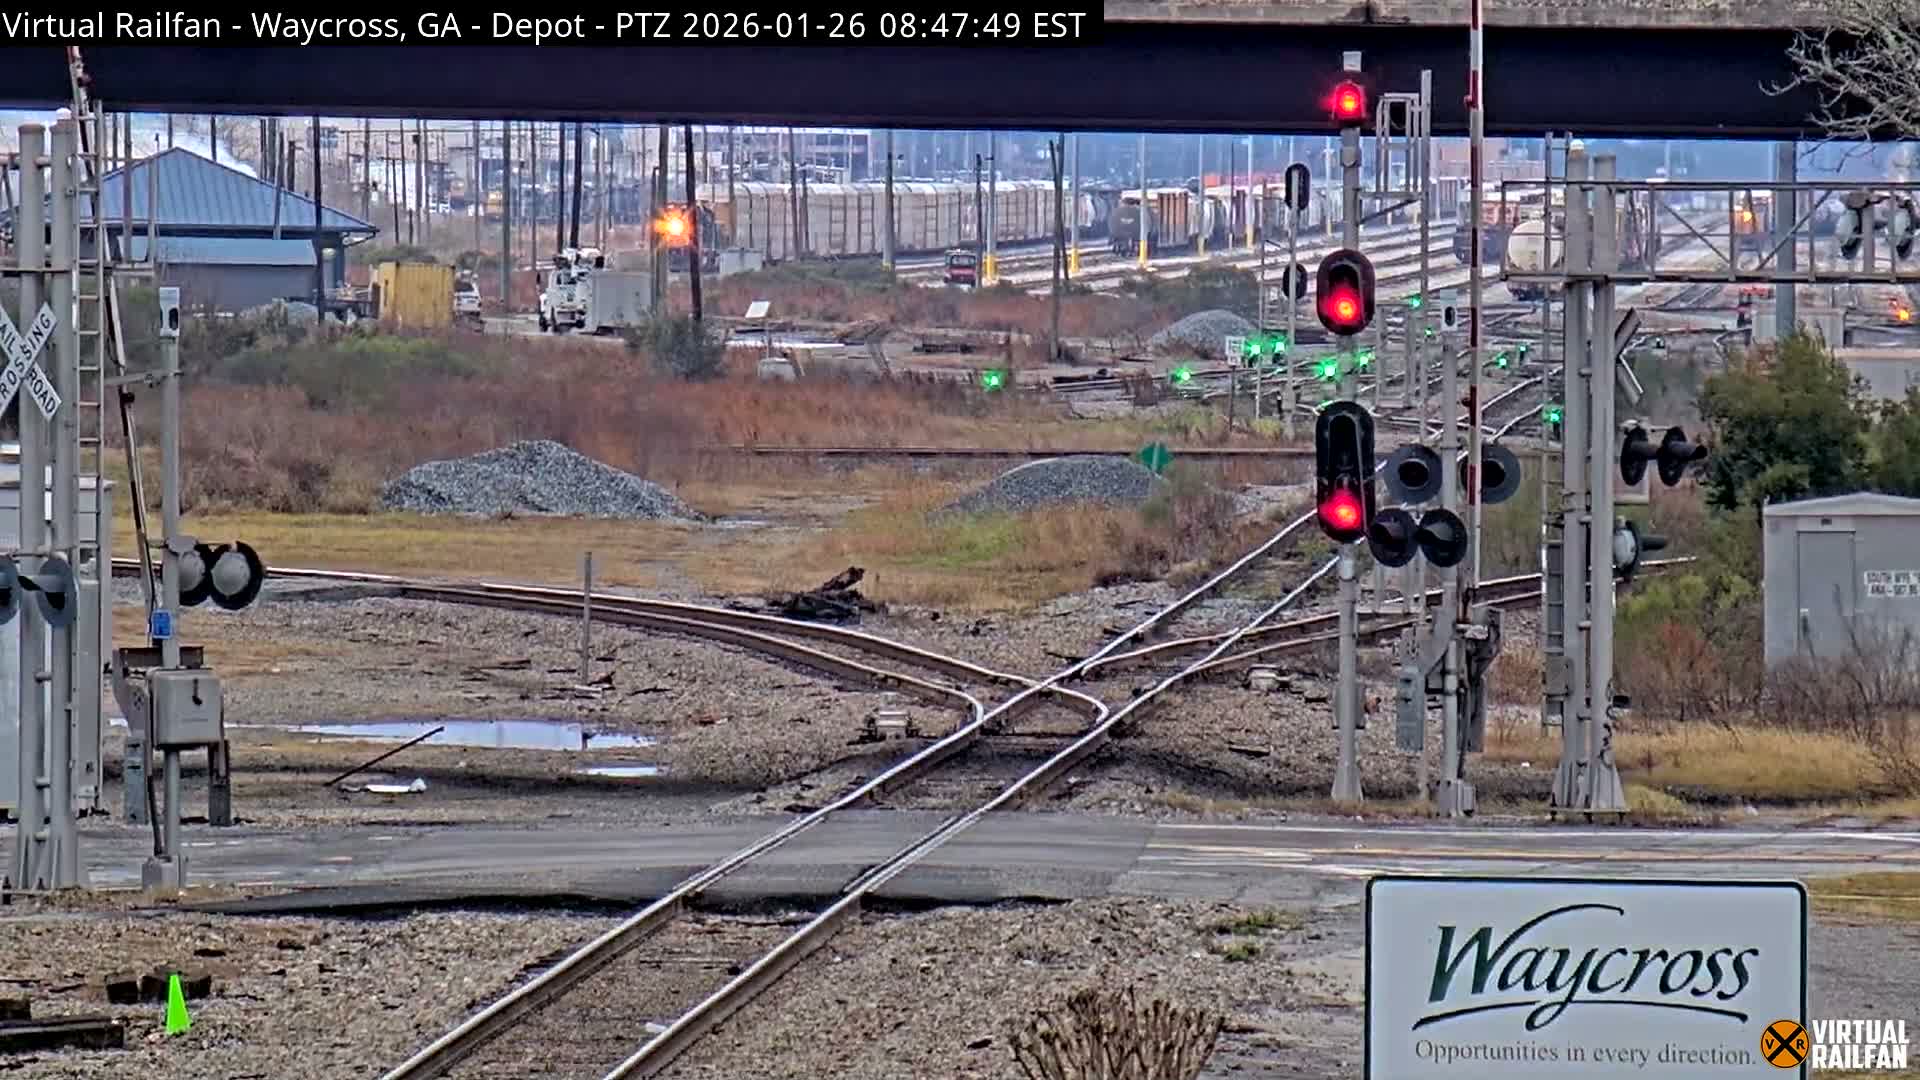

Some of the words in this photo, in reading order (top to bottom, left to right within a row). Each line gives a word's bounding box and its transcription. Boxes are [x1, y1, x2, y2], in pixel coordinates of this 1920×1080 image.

[0, 313, 51, 400] ROSSING
[0, 323, 16, 356] AIL
[28, 368, 57, 414] ROAD
[1427, 903, 1760, 1031] Waycross
[1414, 1039, 1559, 1064] Opportunities
[1567, 1041, 1585, 1063] in
[1593, 1045, 1650, 1069] every
[1657, 1042, 1757, 1066] direction.
